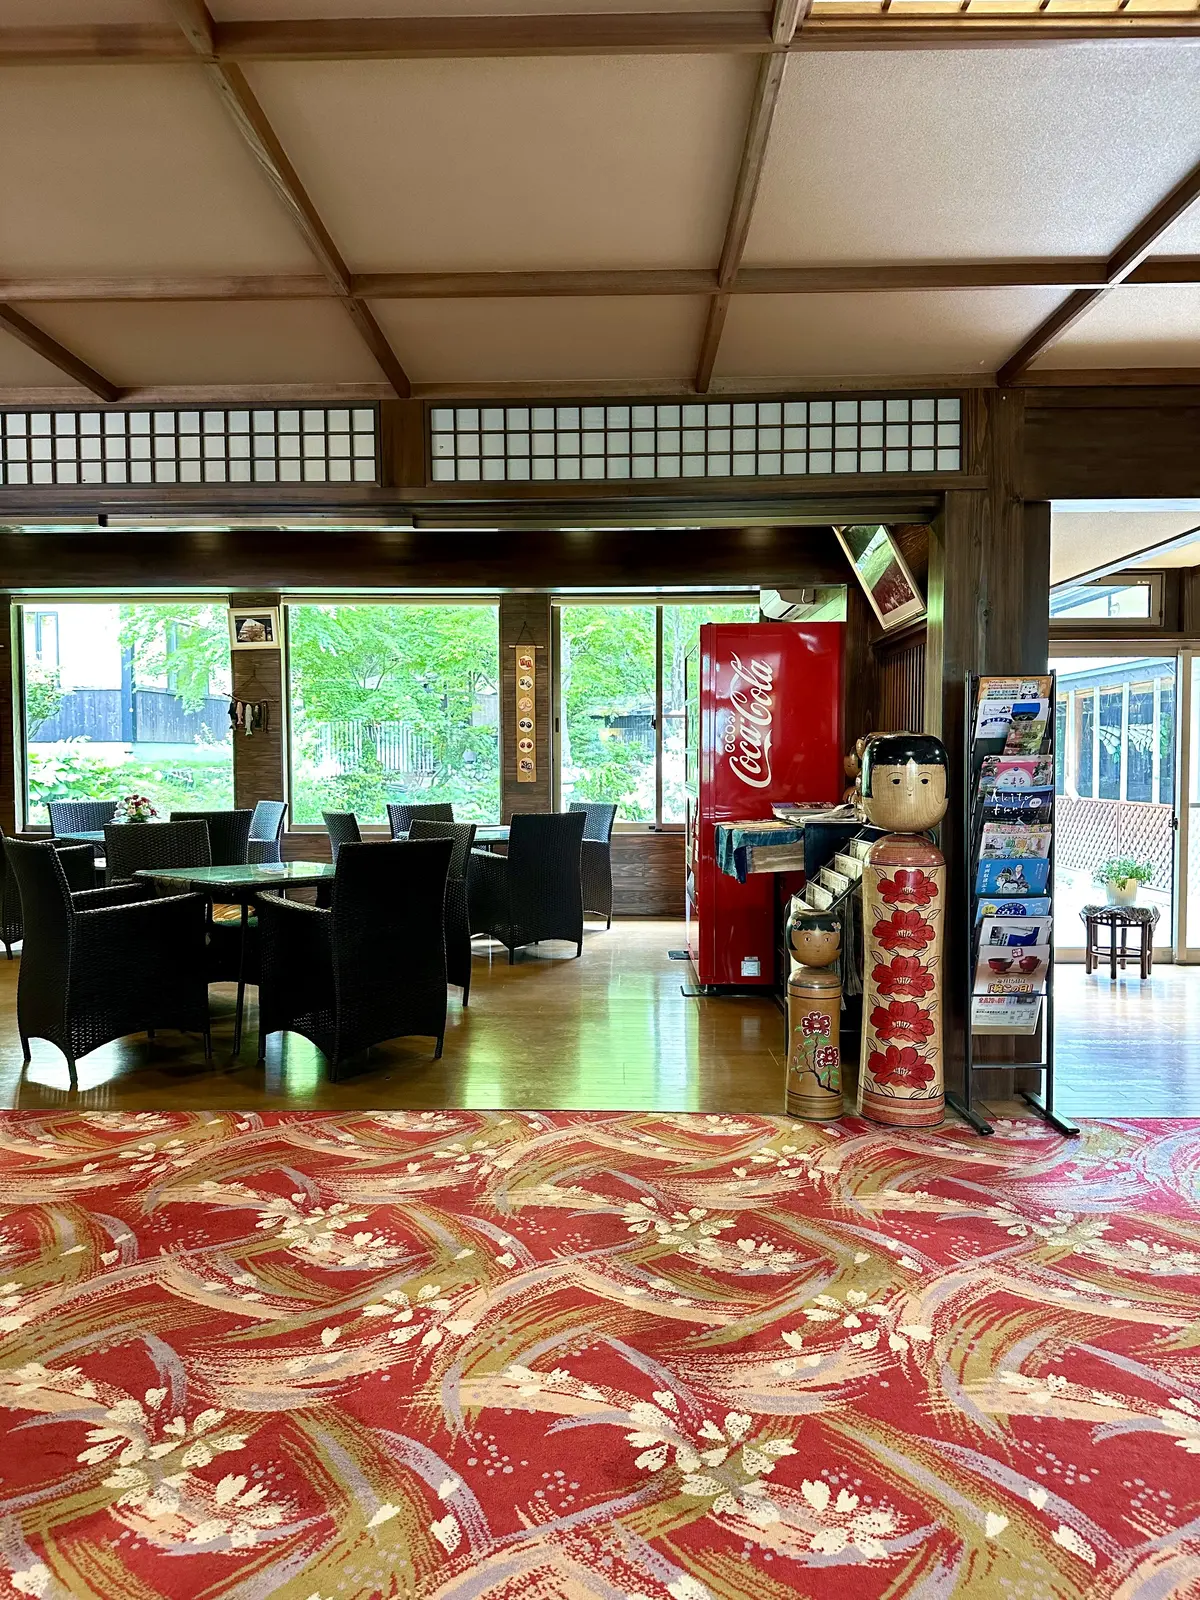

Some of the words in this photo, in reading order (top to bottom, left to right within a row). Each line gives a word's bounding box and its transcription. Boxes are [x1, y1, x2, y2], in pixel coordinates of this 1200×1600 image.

[729, 651, 773, 788] Coca-Cola
[1002, 776, 1025, 786] こまち
[990, 788, 1033, 803] Akita
